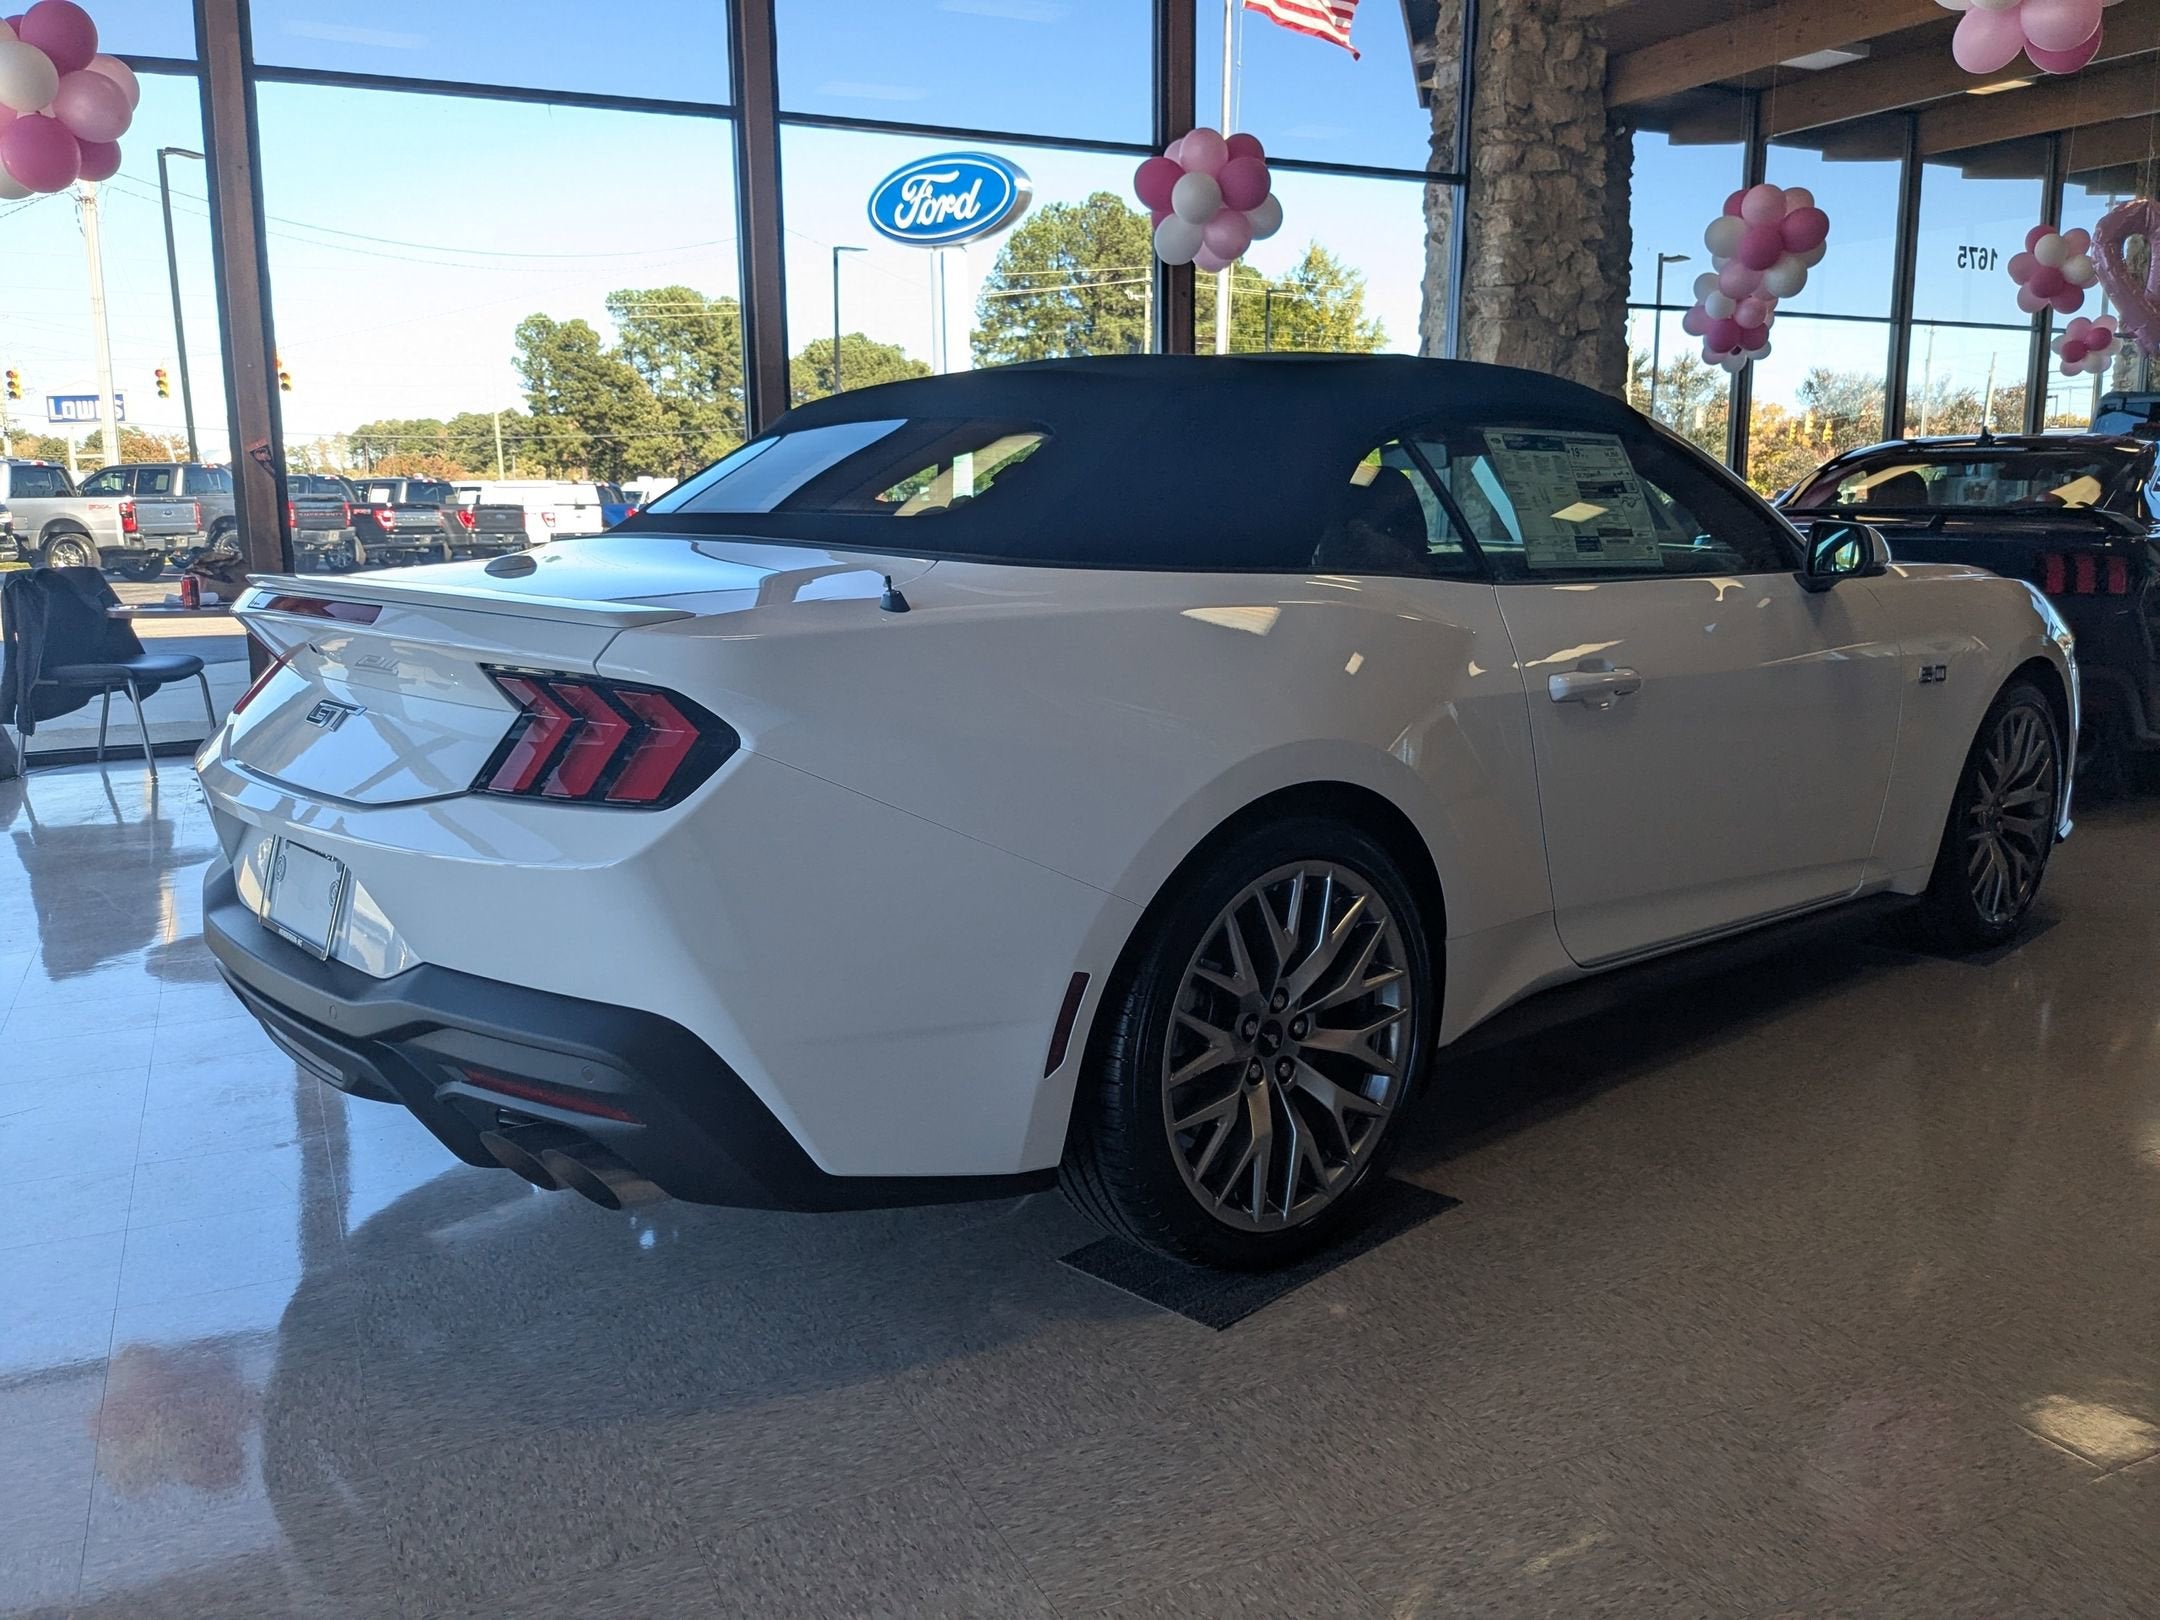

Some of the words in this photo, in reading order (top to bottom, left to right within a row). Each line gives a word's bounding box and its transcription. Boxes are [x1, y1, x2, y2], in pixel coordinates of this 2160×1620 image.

[894, 169, 984, 230] Ford
[48, 398, 124, 420] LOWS
[1919, 665, 1947, 684] 50
[304, 698, 368, 733] GT
